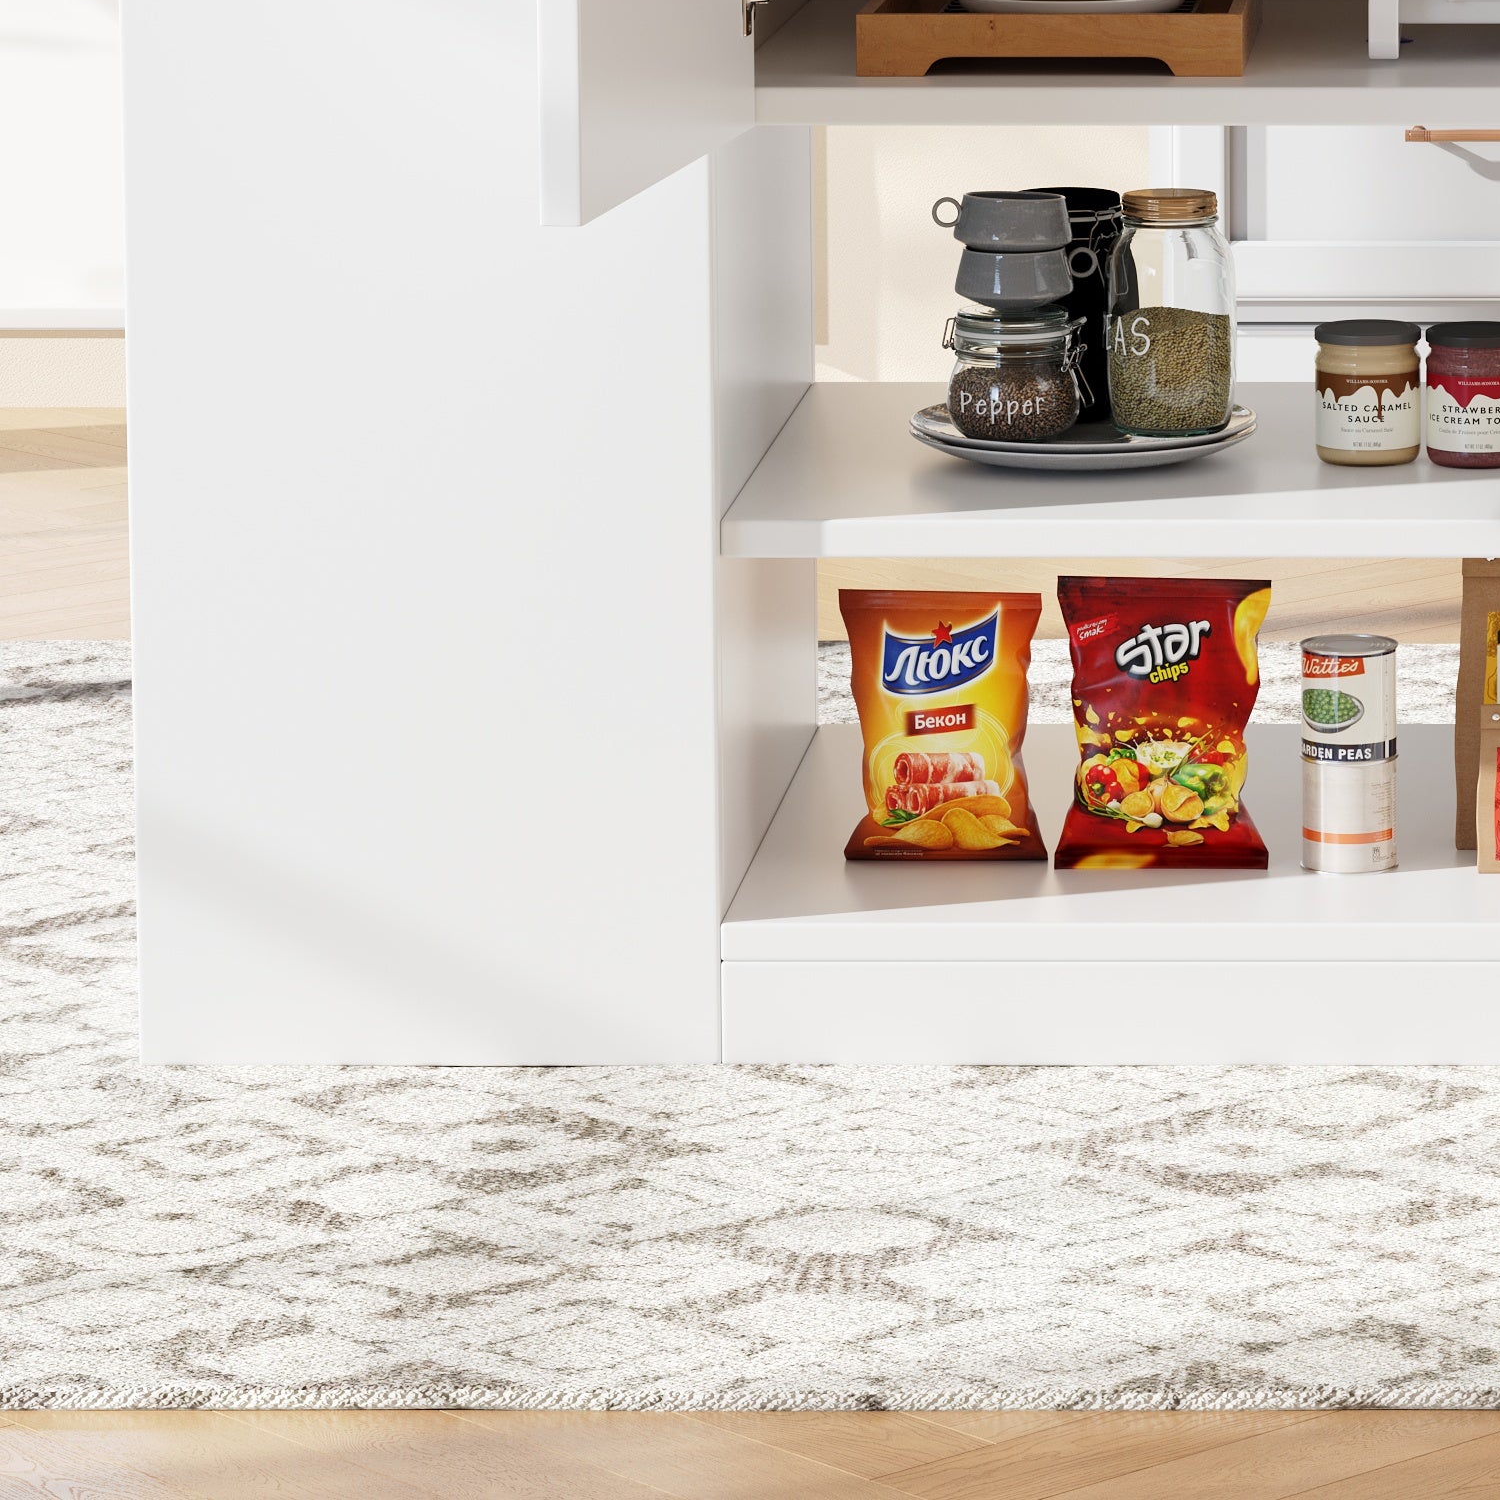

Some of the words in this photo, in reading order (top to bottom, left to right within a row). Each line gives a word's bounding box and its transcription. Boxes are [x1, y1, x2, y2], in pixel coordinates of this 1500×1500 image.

[960, 390, 1045, 425] Pepper
[1322, 402, 1358, 412] SALTED
[1364, 402, 1411, 412] CARAMEL
[1429, 413, 1440, 422] ICE
[1443, 416, 1480, 425] CREAM
[1079, 624, 1105, 641] smak
[885, 635, 989, 686] Люкс
[1303, 657, 1359, 675] Wattie's
[1149, 662, 1189, 683] chips
[914, 713, 966, 730] Бекон
[1302, 743, 1333, 759] ARDEN
[1338, 748, 1372, 760] PEAS
